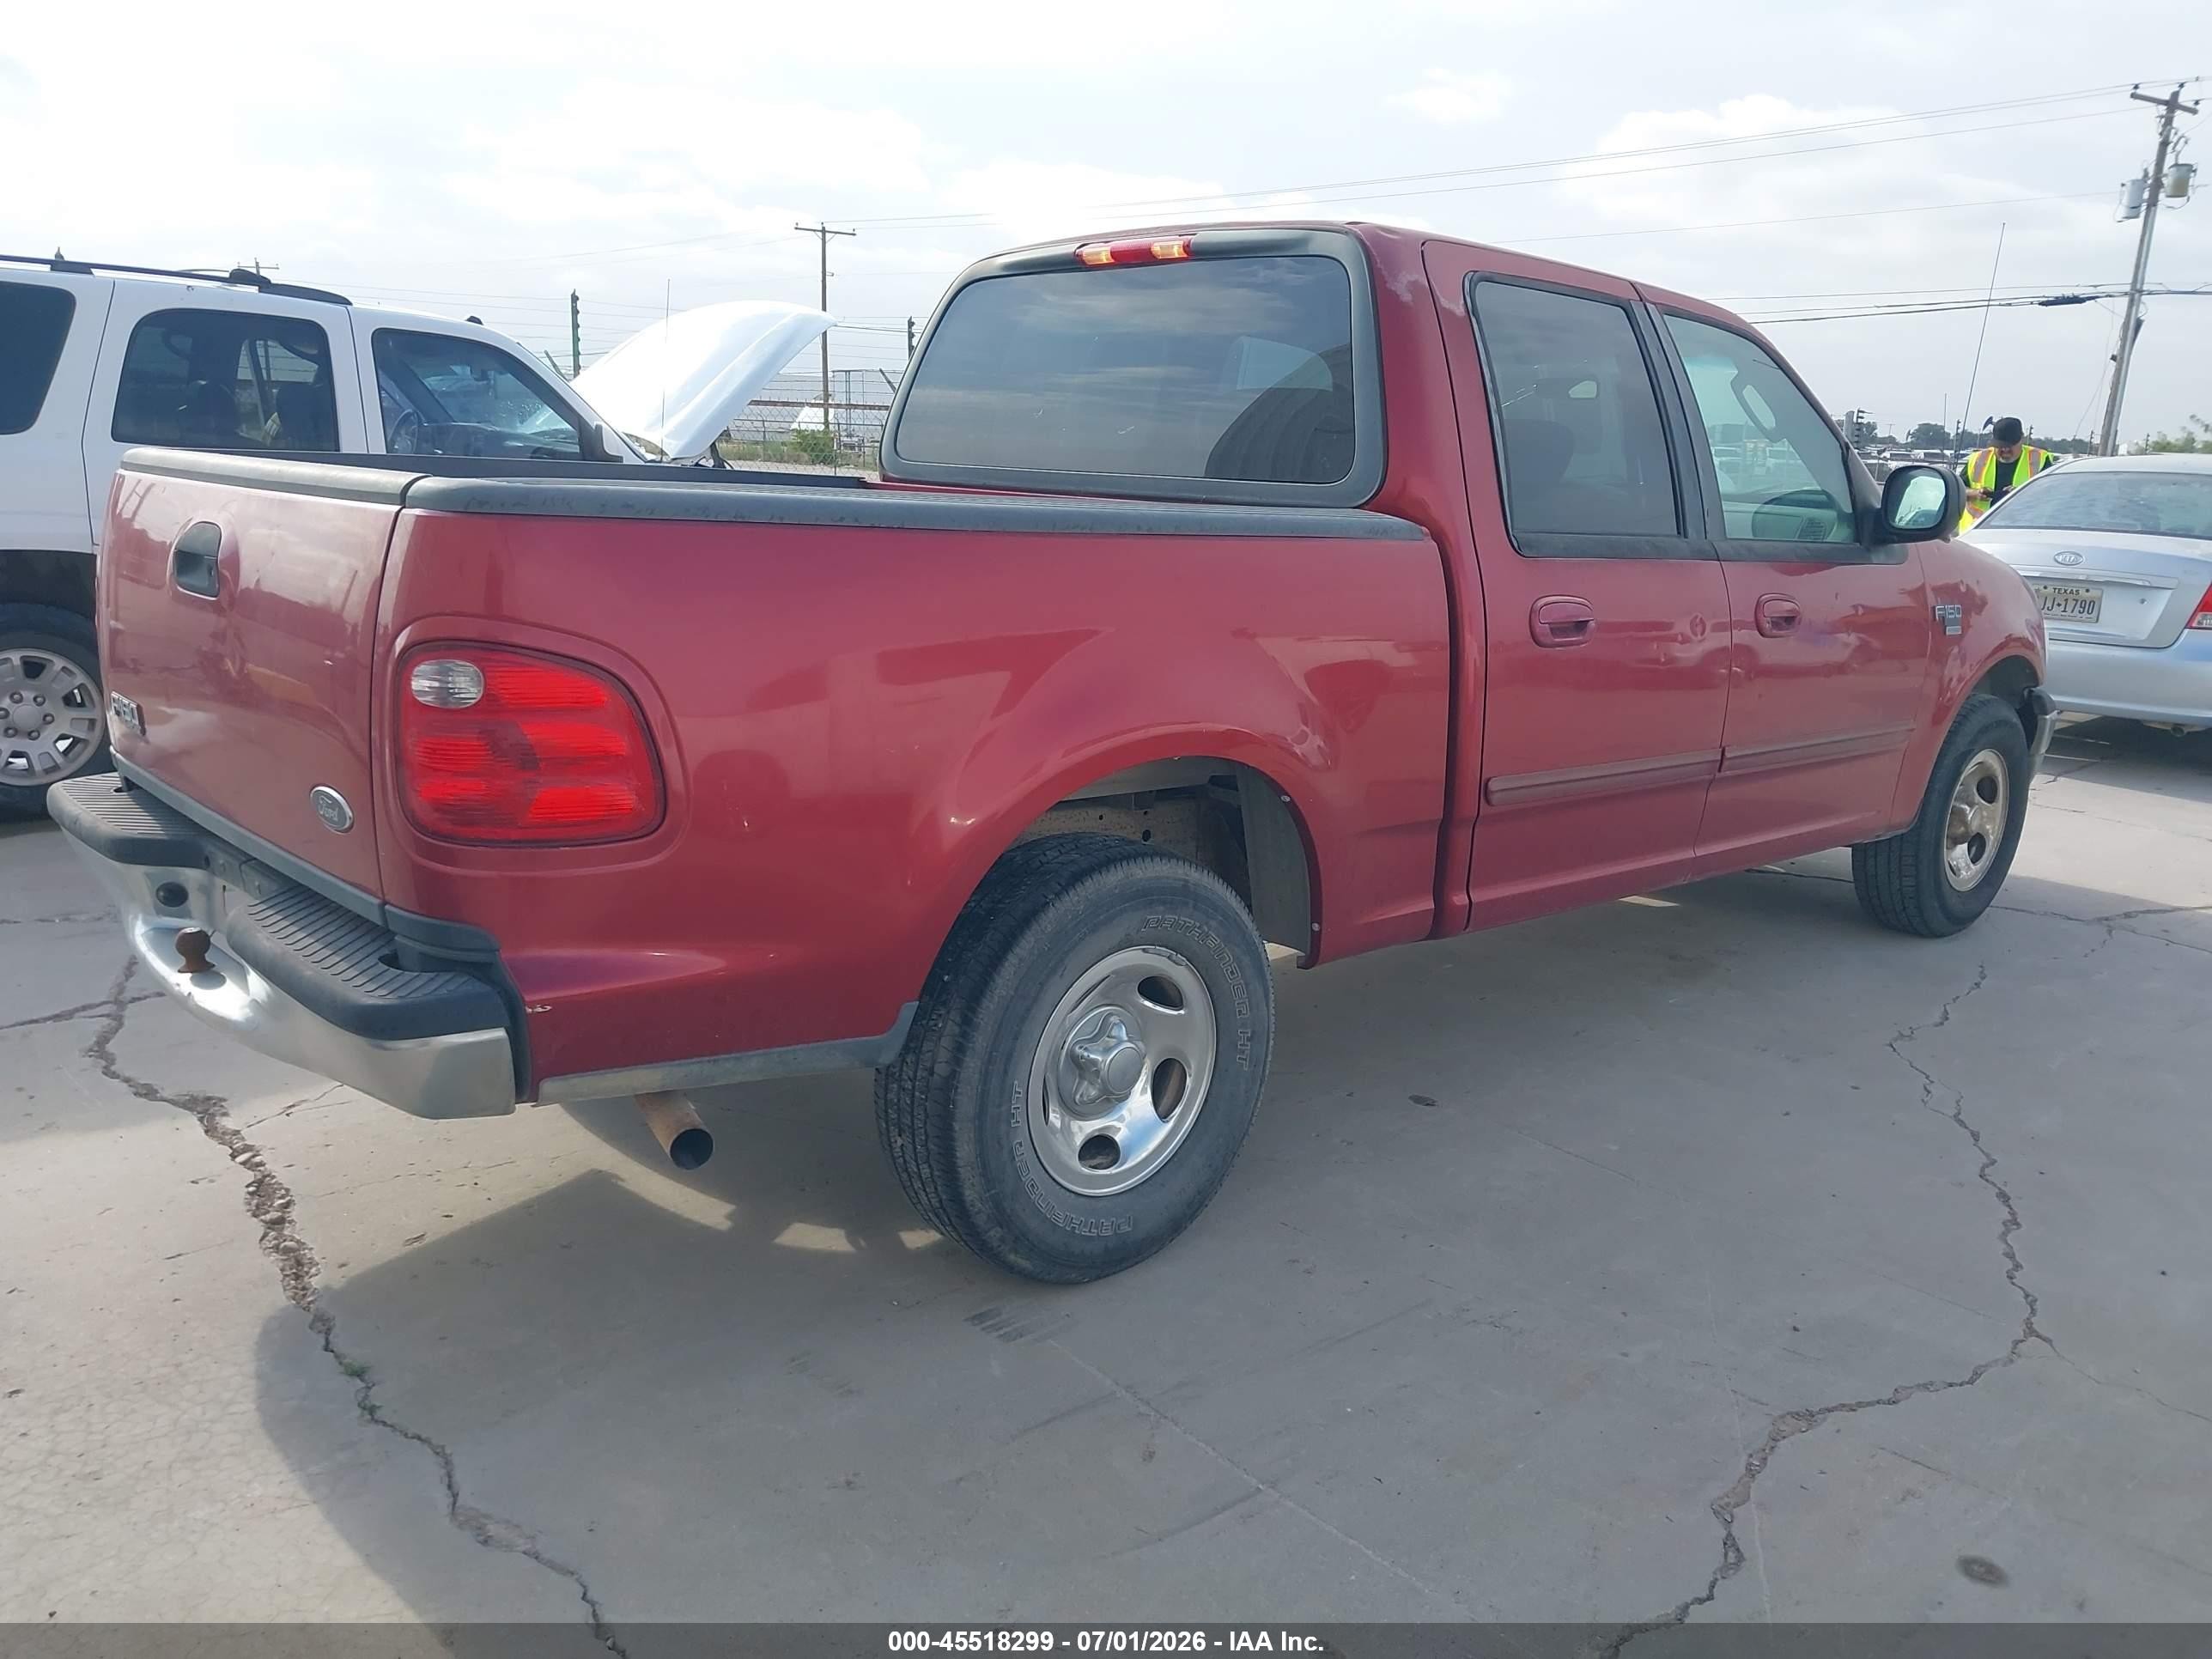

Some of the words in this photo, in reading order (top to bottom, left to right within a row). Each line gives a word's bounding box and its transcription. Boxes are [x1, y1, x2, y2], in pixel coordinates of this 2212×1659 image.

[2052, 587, 2080, 596] TEXAS
[1141, 915, 1250, 1018] PATHFINDER
[1236, 1028, 1252, 1072] HT
[1011, 1079, 1024, 1127] HT
[1013, 1139, 1133, 1237] PATHFINDER
